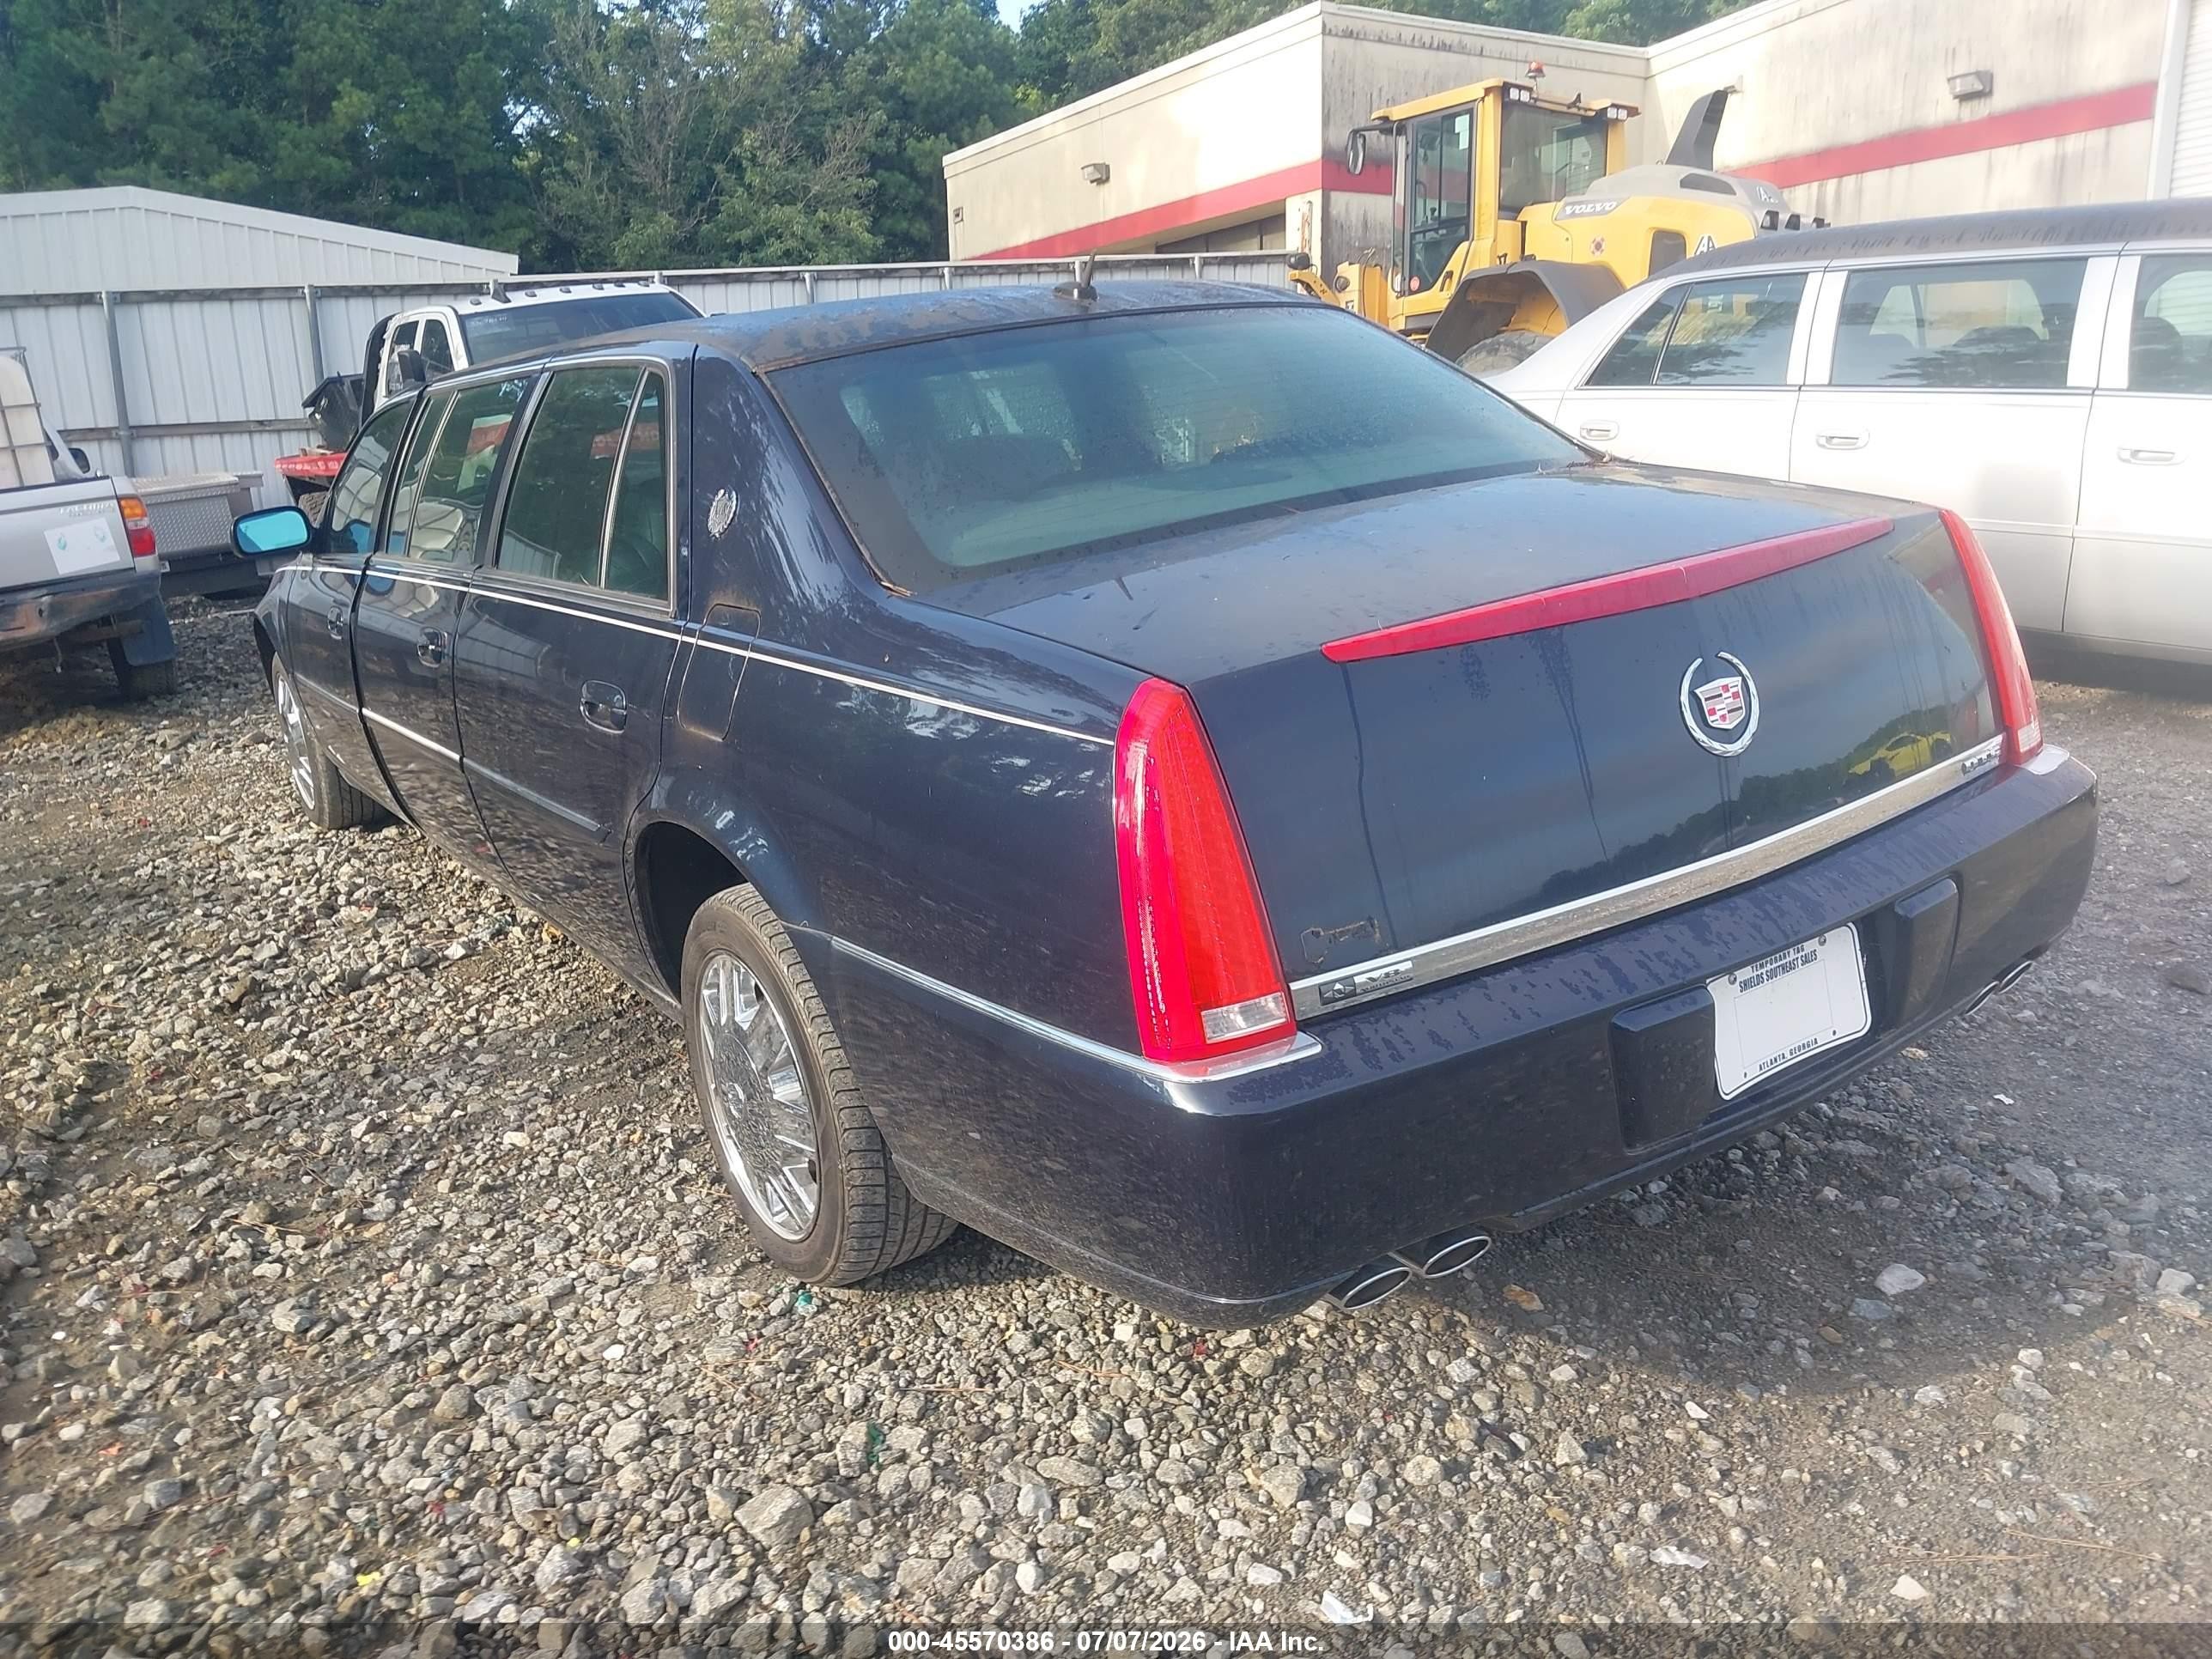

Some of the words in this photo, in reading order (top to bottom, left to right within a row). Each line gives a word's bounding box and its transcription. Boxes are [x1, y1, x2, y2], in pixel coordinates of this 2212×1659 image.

[1565, 201, 1617, 215] VOLVO
[1739, 971, 1765, 993] SHIELDS
[1765, 957, 1800, 981] SOUTHEAST
[1800, 949, 1817, 966] SALES
[1751, 950, 1790, 973] TEMPORARY
[1793, 945, 1805, 955] TAG
[1759, 1052, 1787, 1072] ATLANTA,
[1789, 1037, 1818, 1056] GEORGIA
